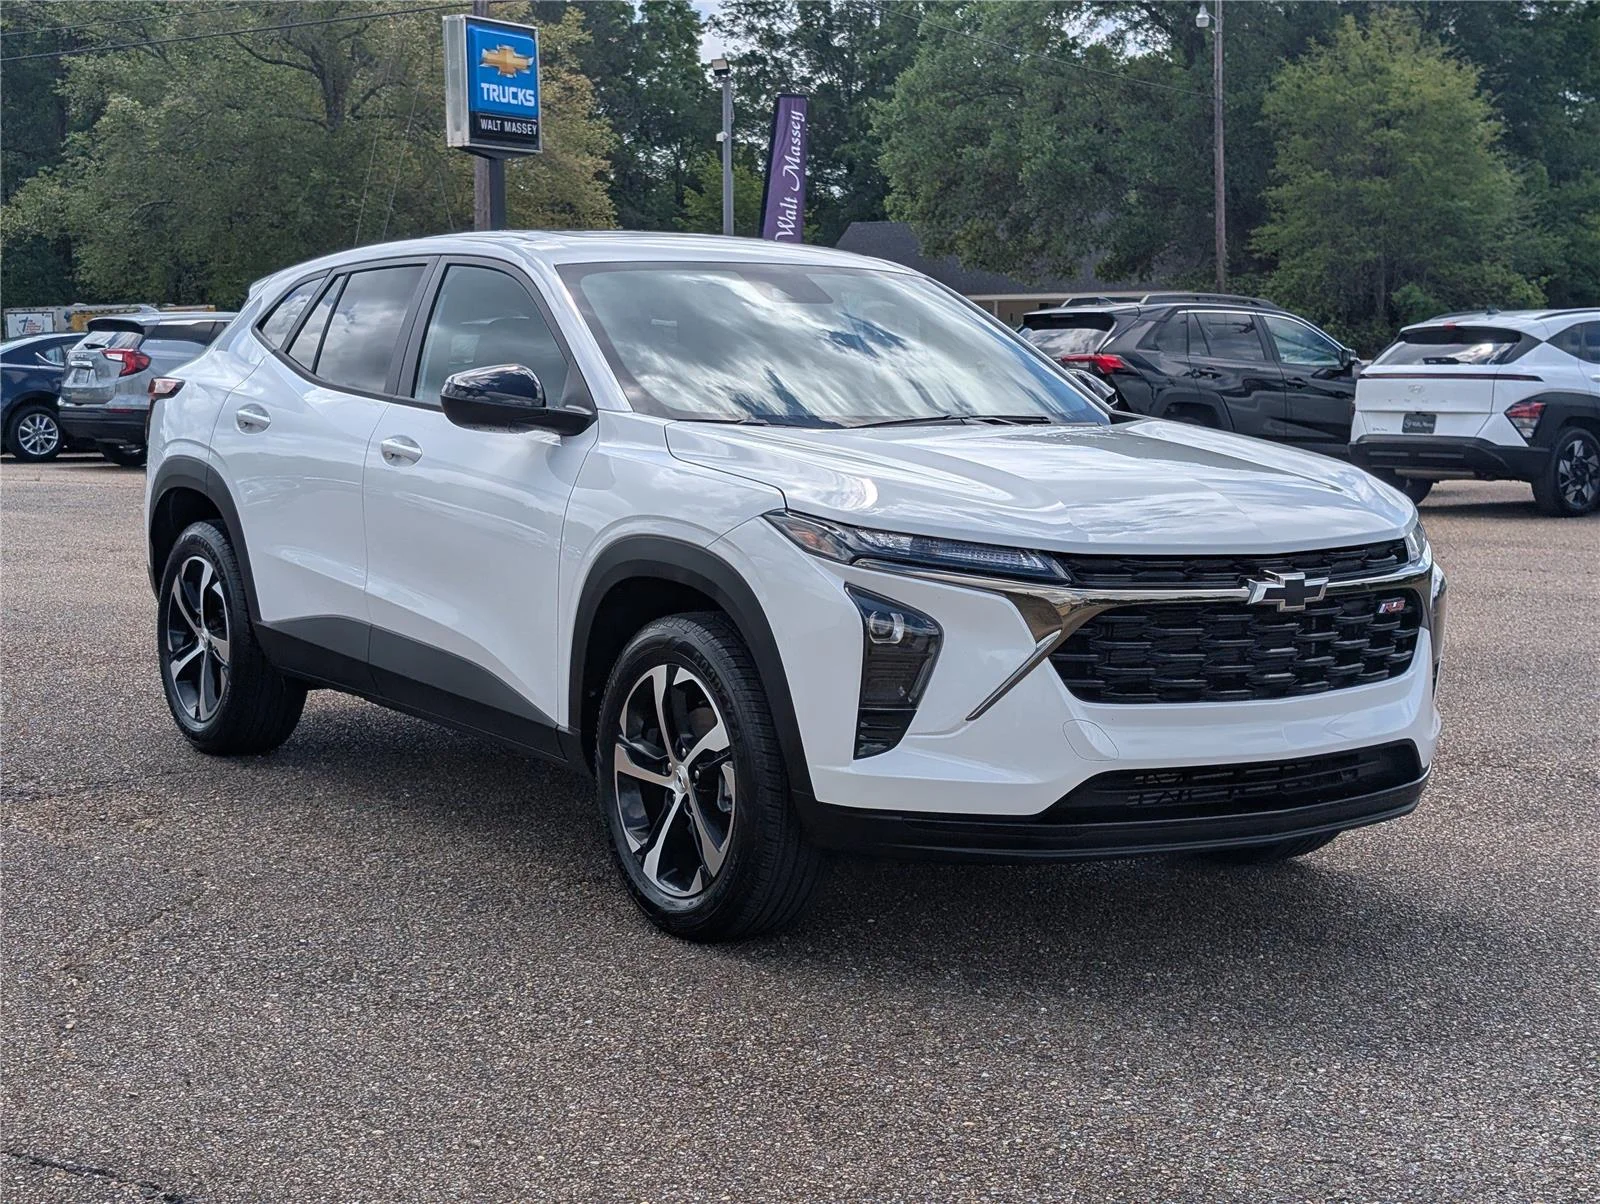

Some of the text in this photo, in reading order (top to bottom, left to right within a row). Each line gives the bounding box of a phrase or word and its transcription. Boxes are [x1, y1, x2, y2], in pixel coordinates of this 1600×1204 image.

[480, 82, 535, 107] TRUCKS
[480, 118, 538, 135] WALT MASSEY
[775, 110, 805, 241] Walt Massey
